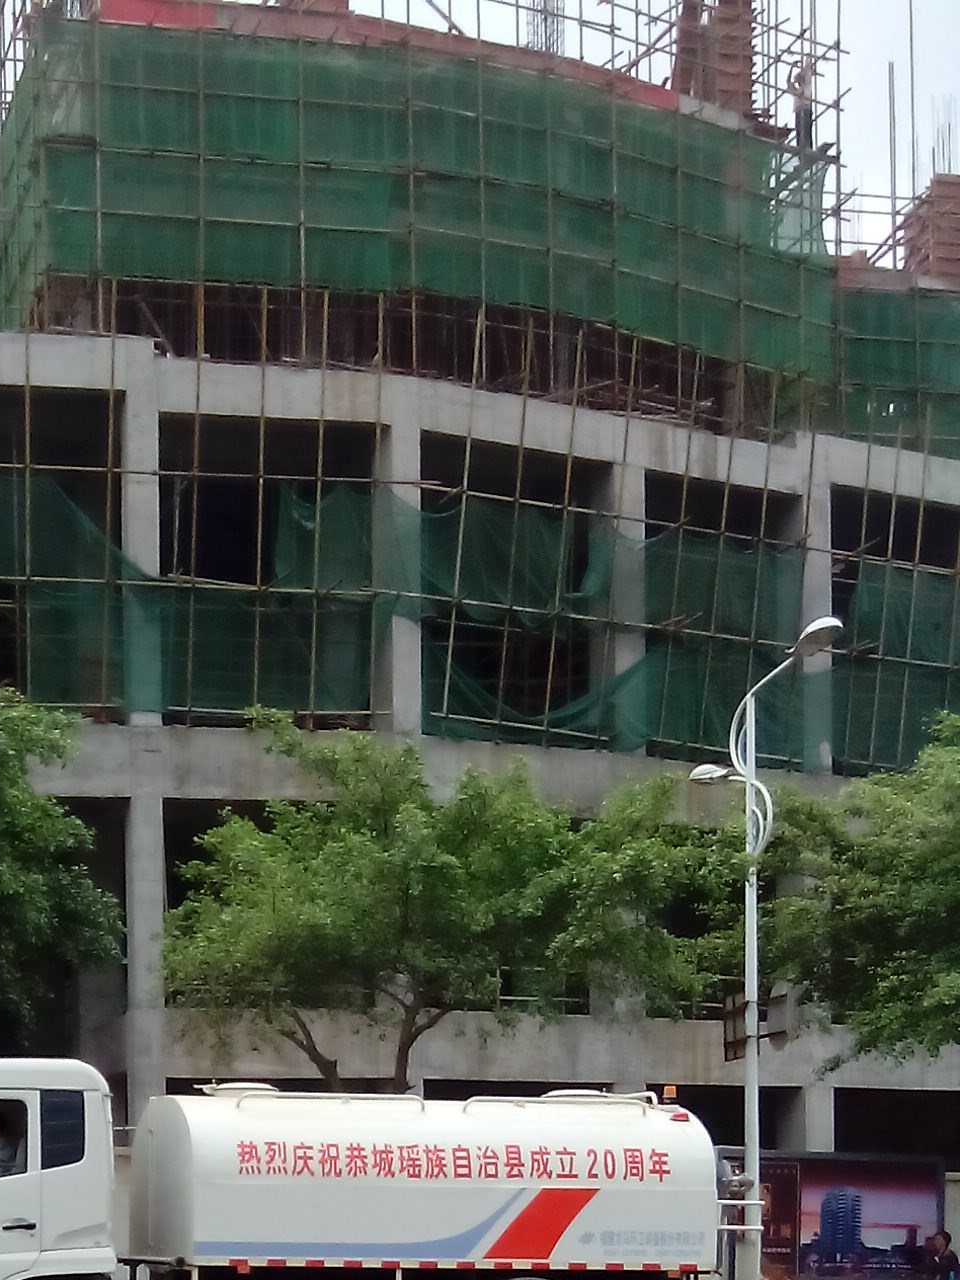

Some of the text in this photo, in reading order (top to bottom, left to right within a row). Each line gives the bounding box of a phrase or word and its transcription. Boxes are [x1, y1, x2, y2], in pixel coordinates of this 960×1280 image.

[237, 1140, 672, 1183] 热烈庆祝恭城瑶族自治县成立20周年
